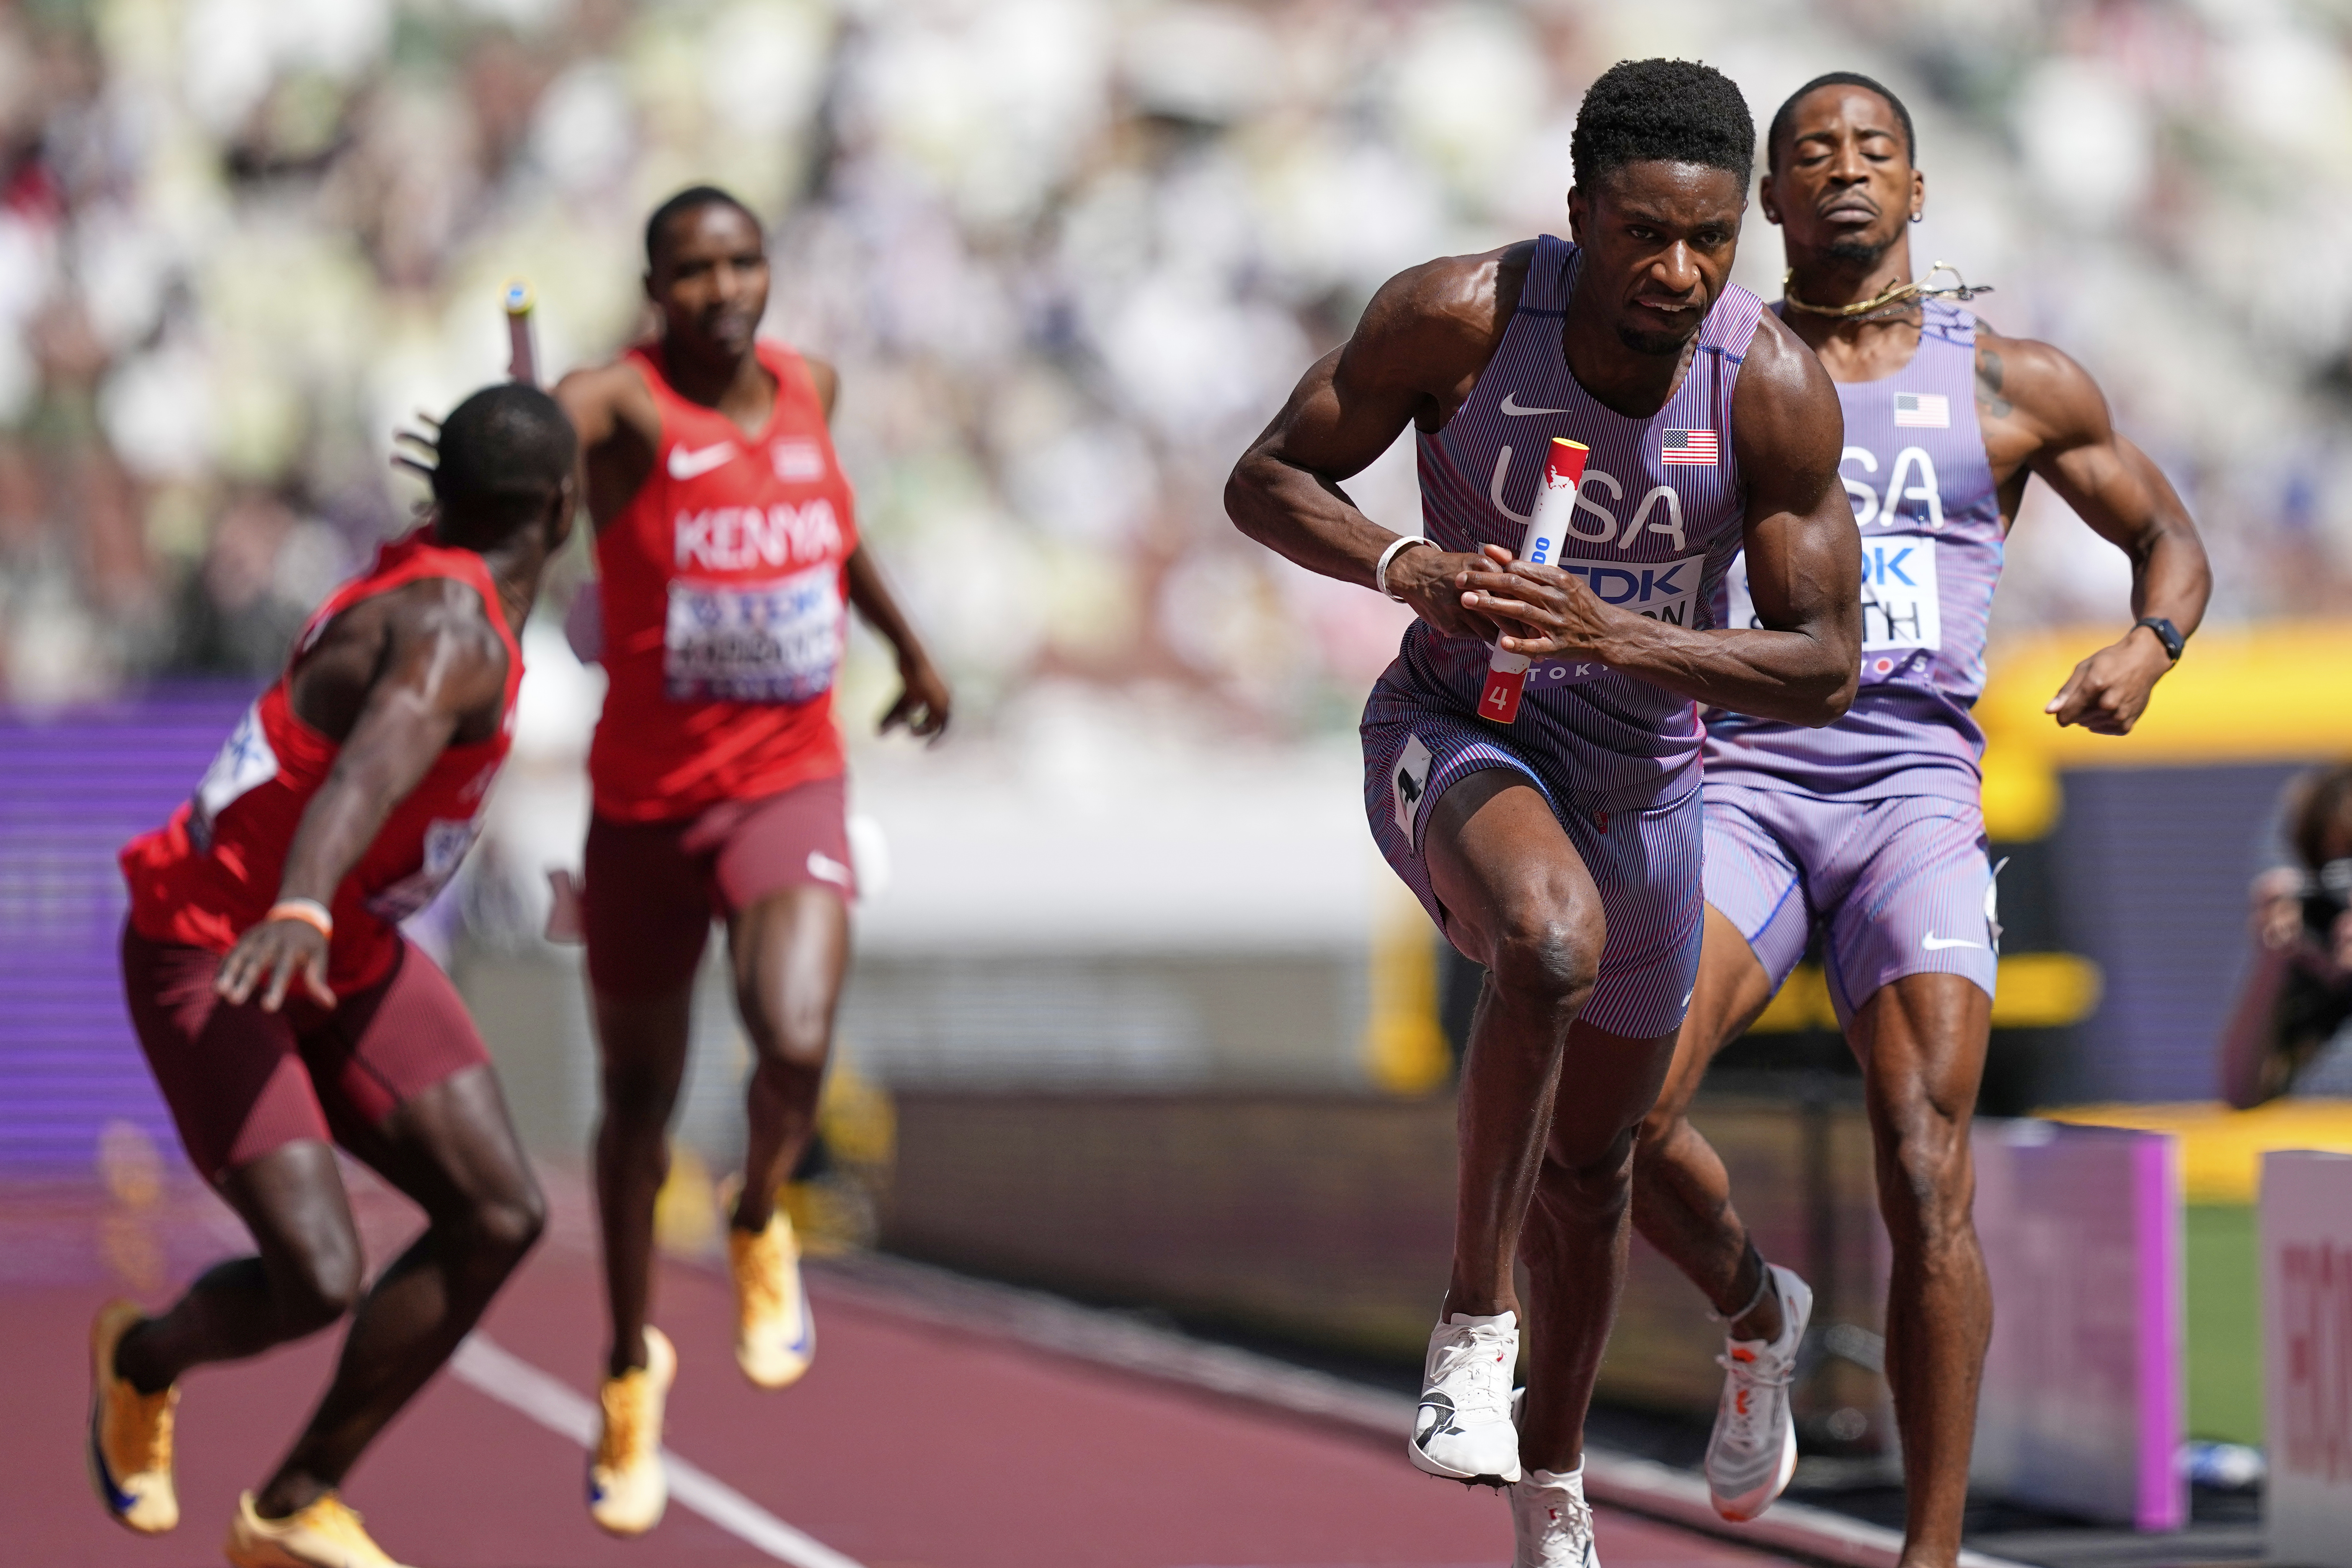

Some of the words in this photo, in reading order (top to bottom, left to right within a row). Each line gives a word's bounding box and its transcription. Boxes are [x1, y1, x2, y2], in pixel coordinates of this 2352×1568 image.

[674, 498, 843, 571] KENYA
[1528, 662, 1608, 682] TOK
[1488, 686, 1508, 710] 4
